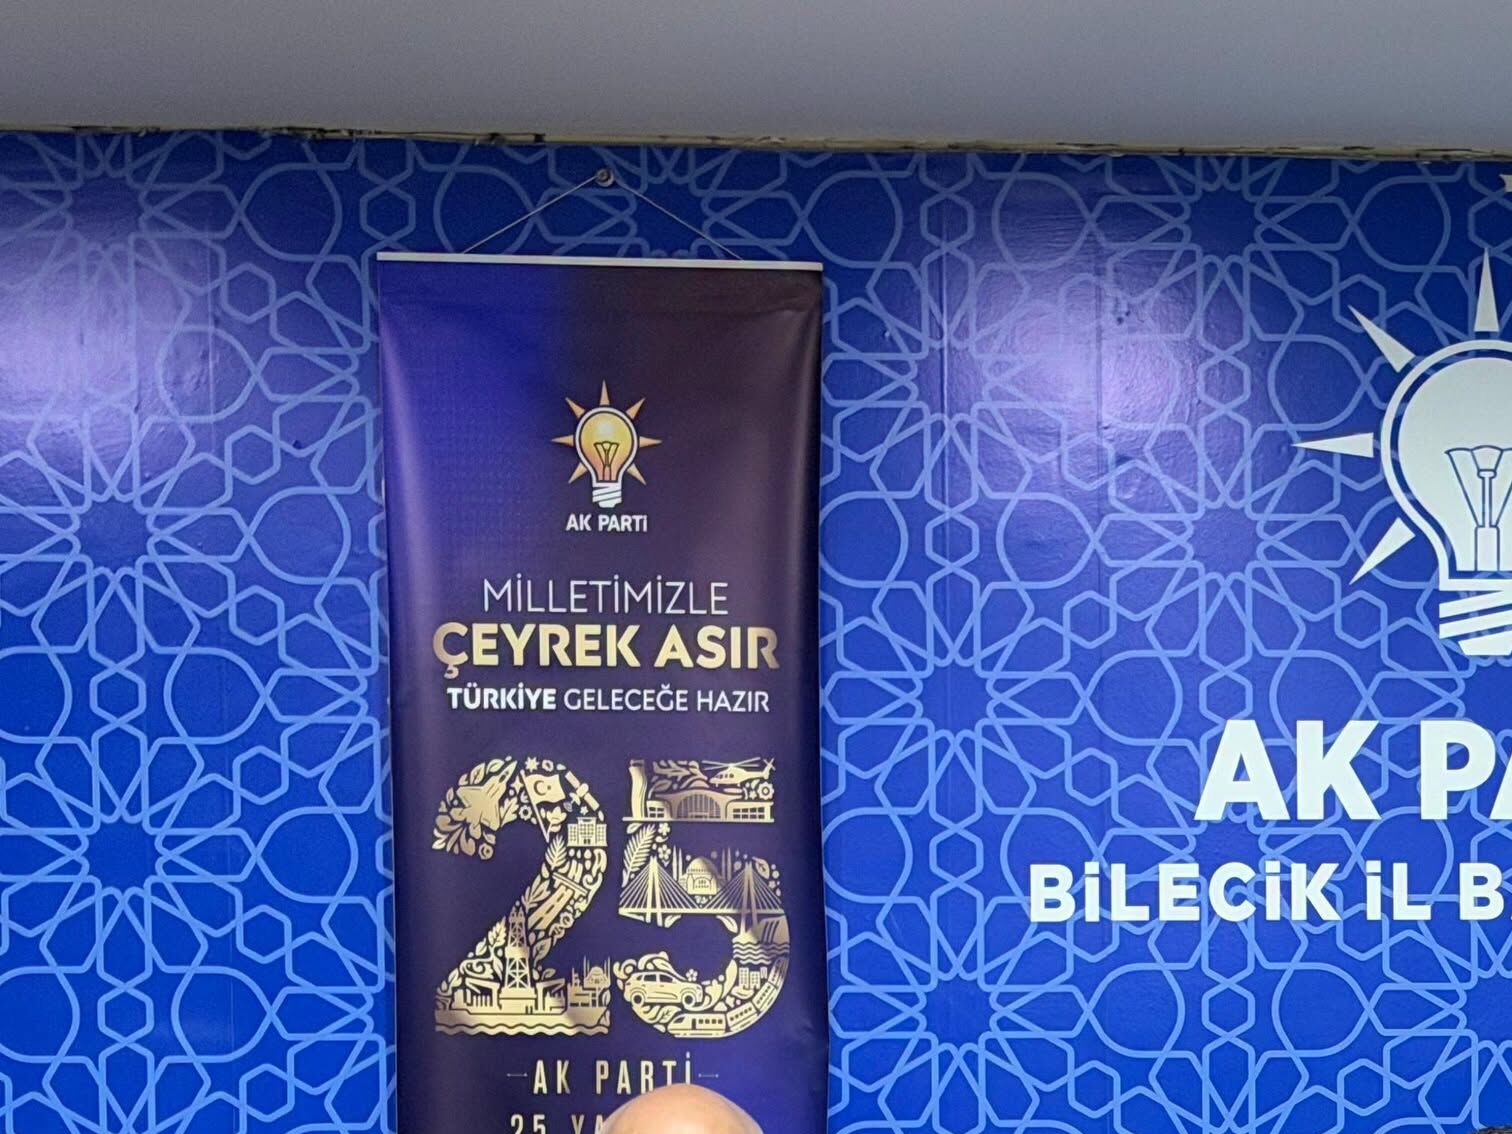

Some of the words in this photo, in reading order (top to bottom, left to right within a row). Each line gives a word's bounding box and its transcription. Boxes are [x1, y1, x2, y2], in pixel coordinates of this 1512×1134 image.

[565, 513, 591, 532] AK
[483, 573, 729, 615] MİLLETİMİZLE
[432, 622, 641, 680] ÇEYREK
[654, 625, 780, 670] ASIR
[447, 682, 557, 710] TÜRKİYE
[564, 683, 689, 711] GELECEĞE
[697, 690, 770, 713] HAZIR
[1194, 719, 1380, 820] AK
[431, 755, 790, 1039] 25
[533, 1059, 571, 1094] AK
[596, 1051, 692, 1094] PARTİ
